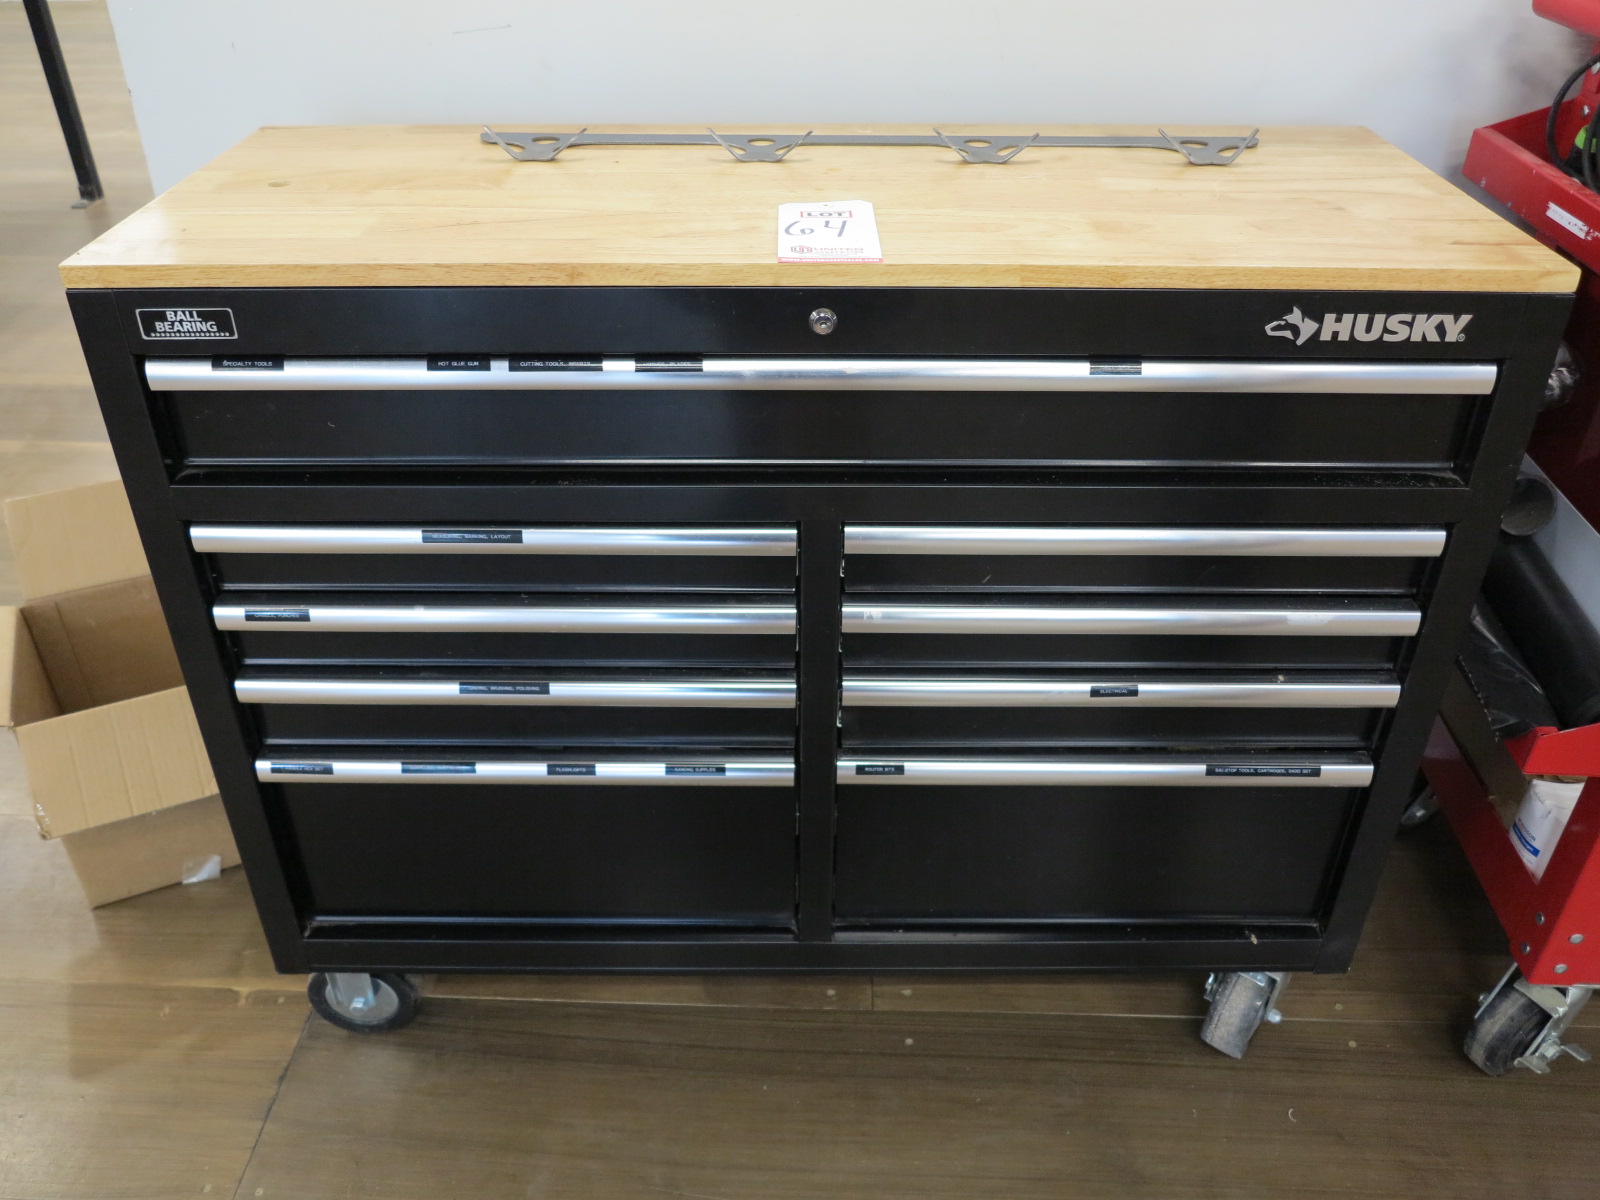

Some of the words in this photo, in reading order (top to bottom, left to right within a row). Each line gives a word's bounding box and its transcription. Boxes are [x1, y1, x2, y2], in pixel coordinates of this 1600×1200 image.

[784, 220, 848, 238] 64
[165, 310, 202, 321] BALL
[154, 321, 218, 332] BEARING
[1319, 313, 1474, 342] HUSKY
